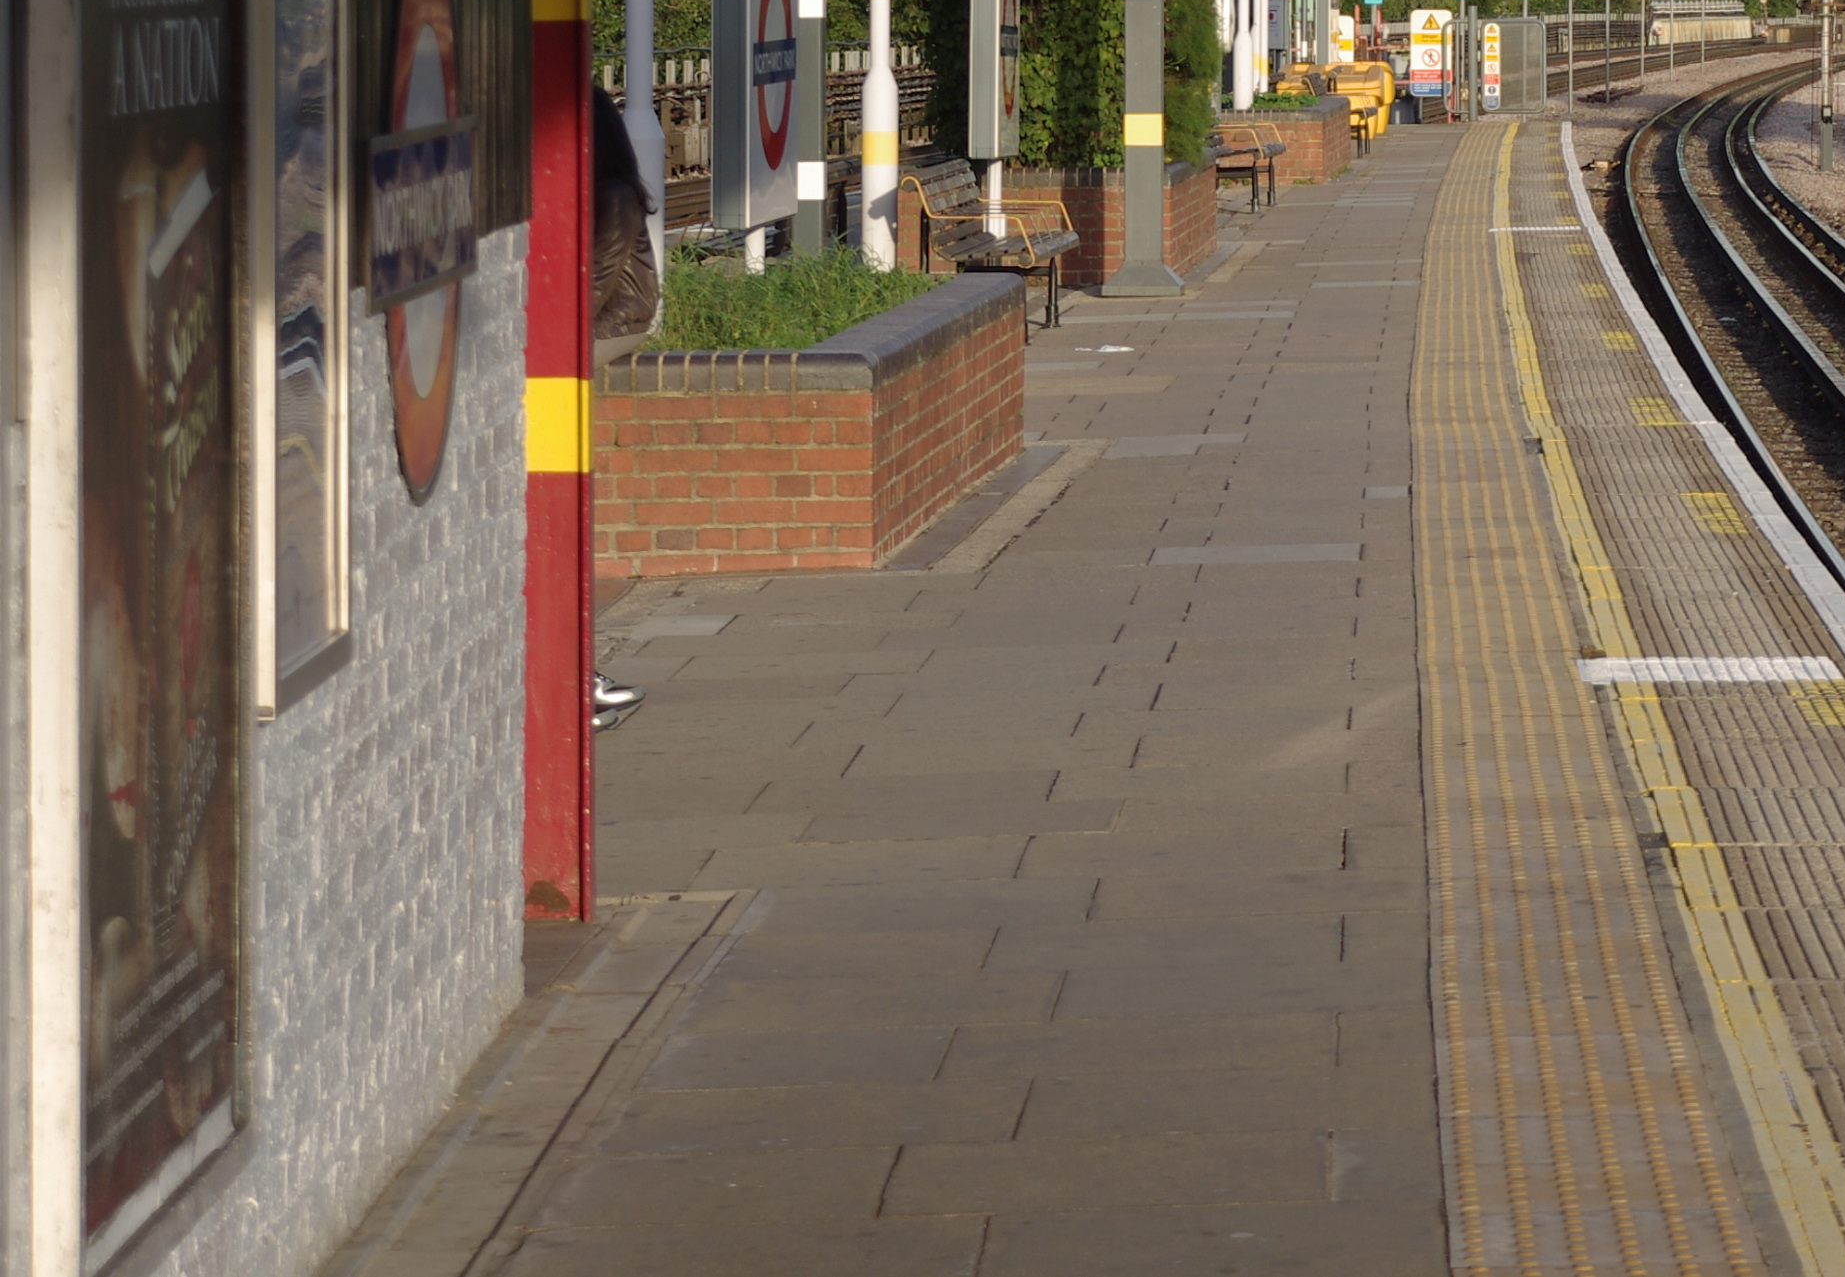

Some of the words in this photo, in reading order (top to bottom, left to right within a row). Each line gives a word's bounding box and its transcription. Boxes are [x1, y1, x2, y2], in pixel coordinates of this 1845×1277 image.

[112, 23, 128, 116] A
[133, 16, 220, 114] NATION
[374, 177, 446, 257] NORTHWICK
[448, 168, 473, 229] PARK
